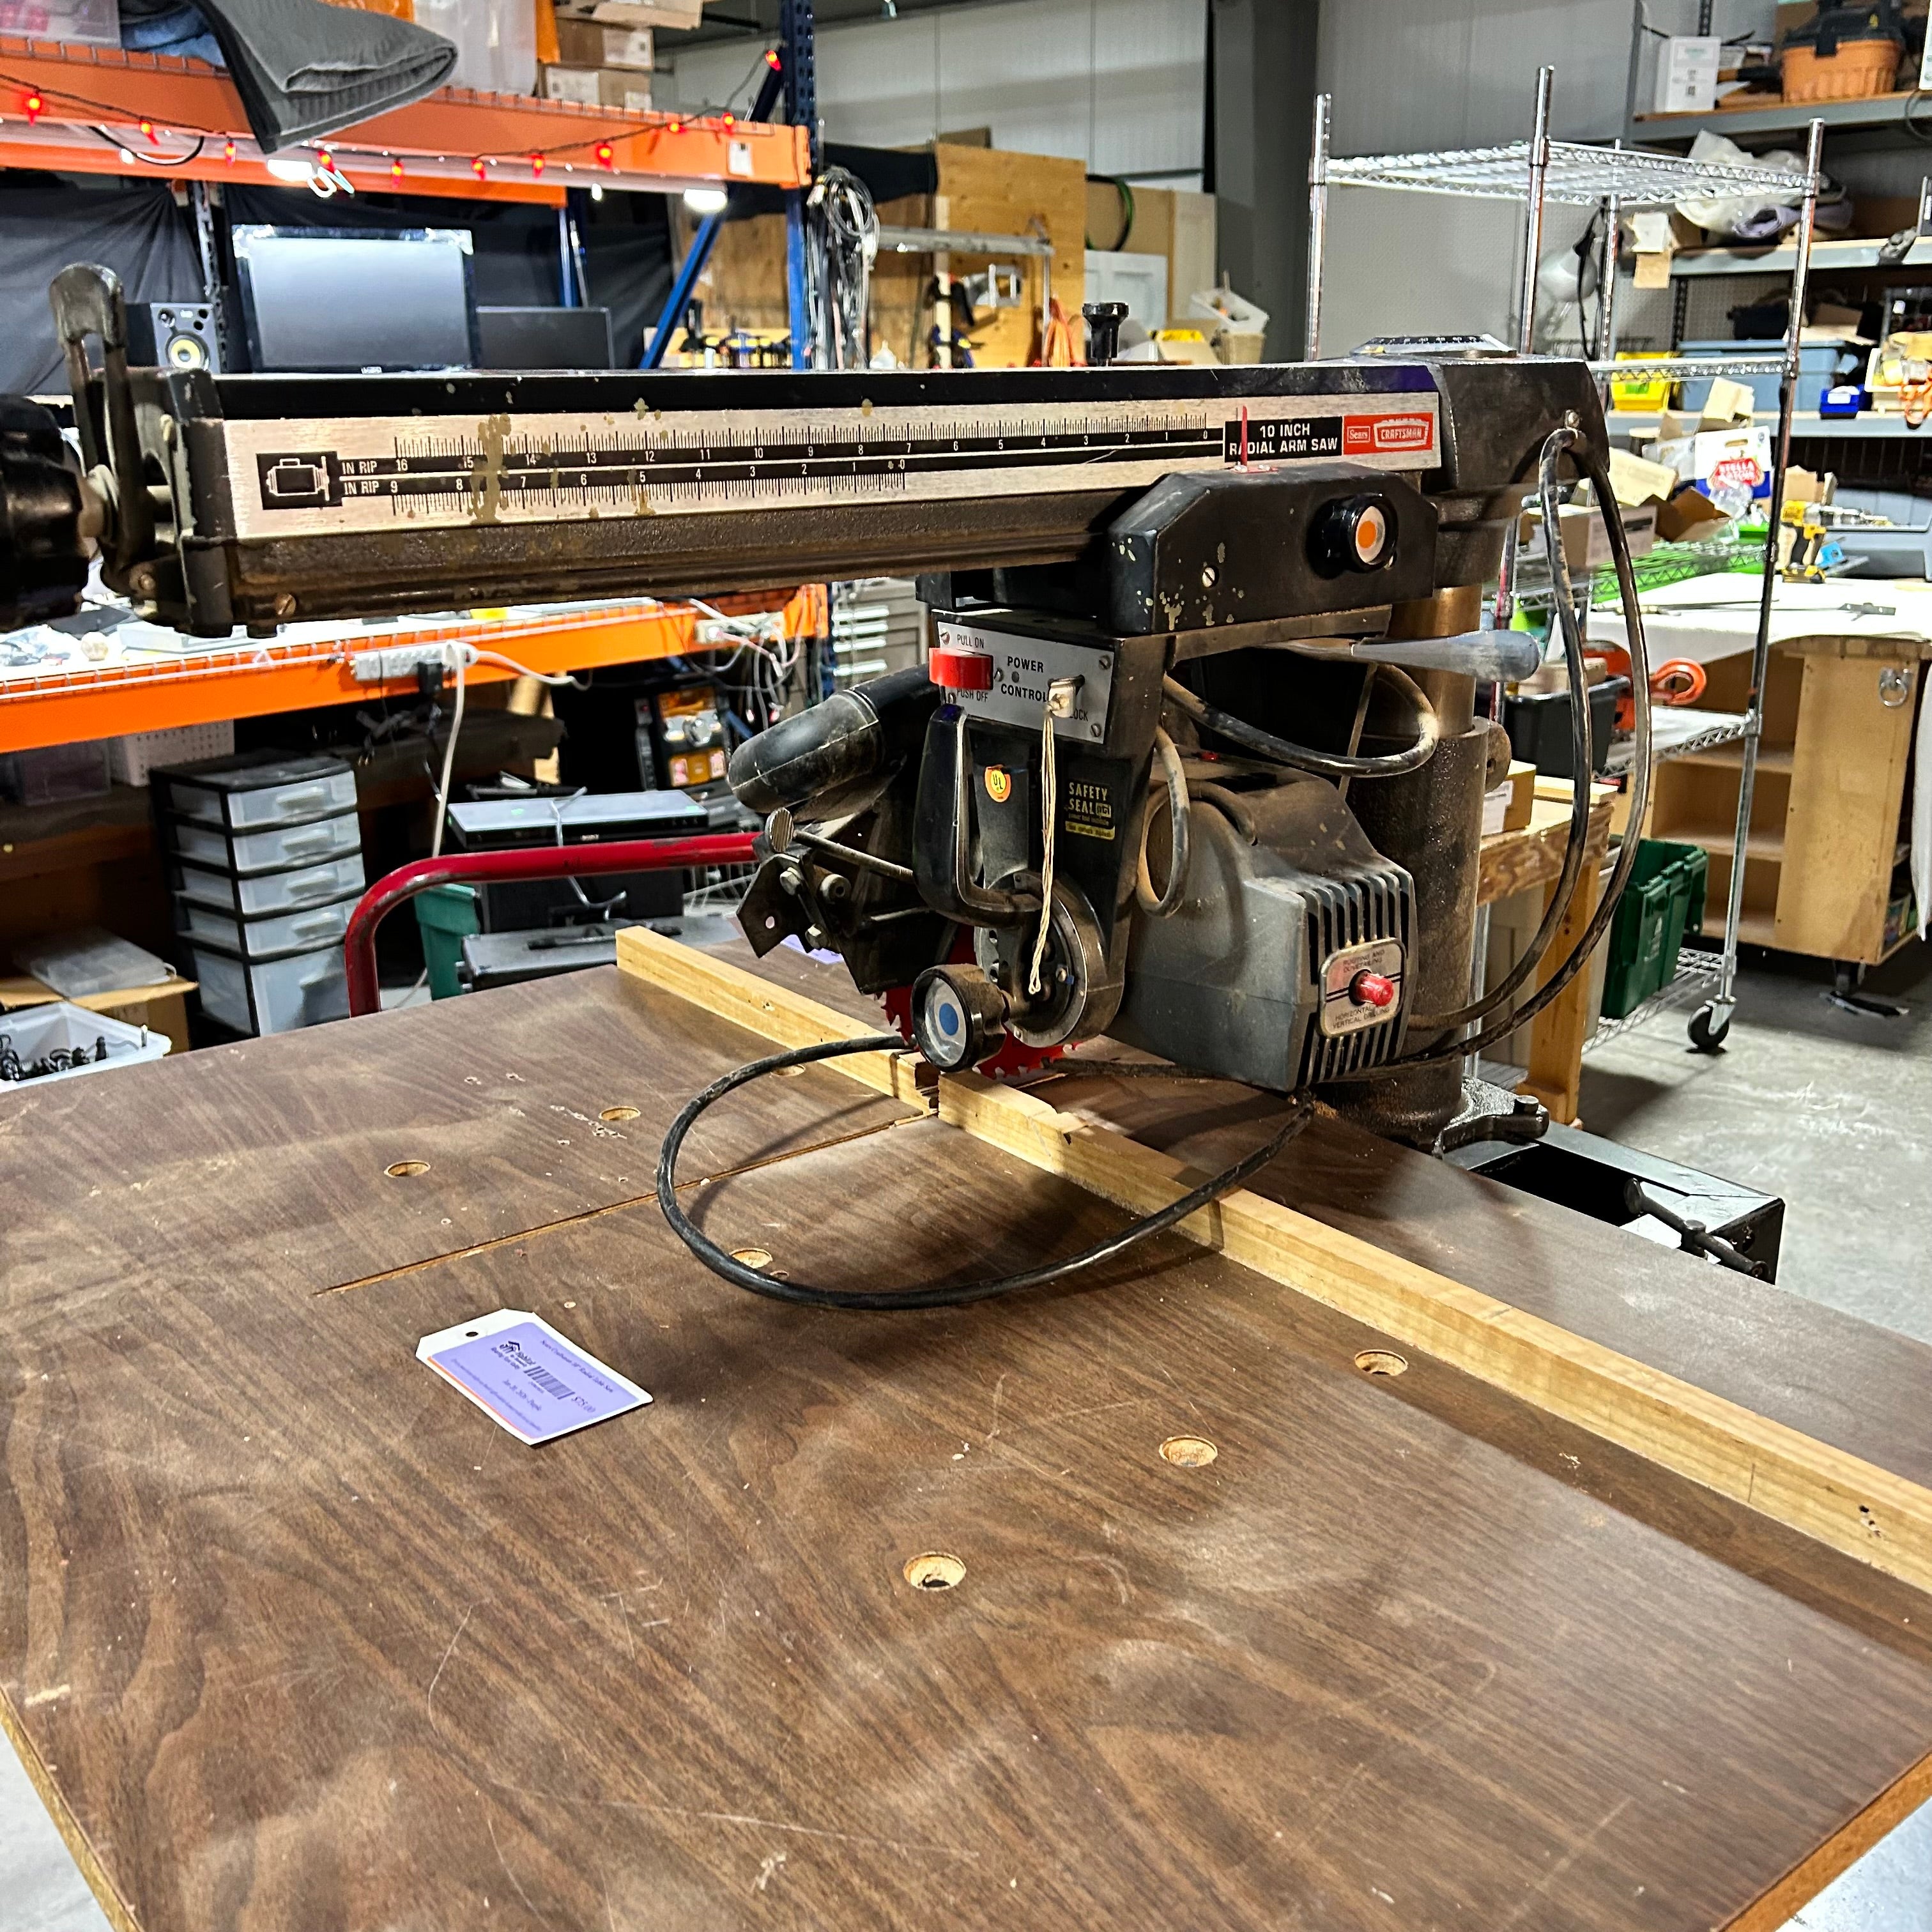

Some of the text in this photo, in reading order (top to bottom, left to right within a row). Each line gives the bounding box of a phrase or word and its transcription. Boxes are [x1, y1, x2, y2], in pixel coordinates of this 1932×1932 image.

[1259, 422, 1310, 438] 10 INCH
[1349, 427, 1422, 440] Sears CRAFTSMAN
[341, 430, 1208, 475] IN RIP 16 15 14 13 12 11 10 9 8 7 6 5 4 3 2 1 0
[1280, 438, 1307, 453] ARM
[1311, 437, 1338, 451] SAW
[344, 459, 905, 495] IN RIP 9 8 7 6 5 4 3 2 1 0
[957, 634, 985, 649] PULL ON
[1007, 656, 1044, 673] POWER
[956, 688, 989, 703] PUSH OFF
[1000, 683, 1047, 702] CONTROL
[1070, 708, 1089, 721] OCK
[1068, 781, 1108, 801] SAFETY
[1068, 797, 1094, 815] SEAL
[1333, 1016, 1362, 1029] VERTICAL
